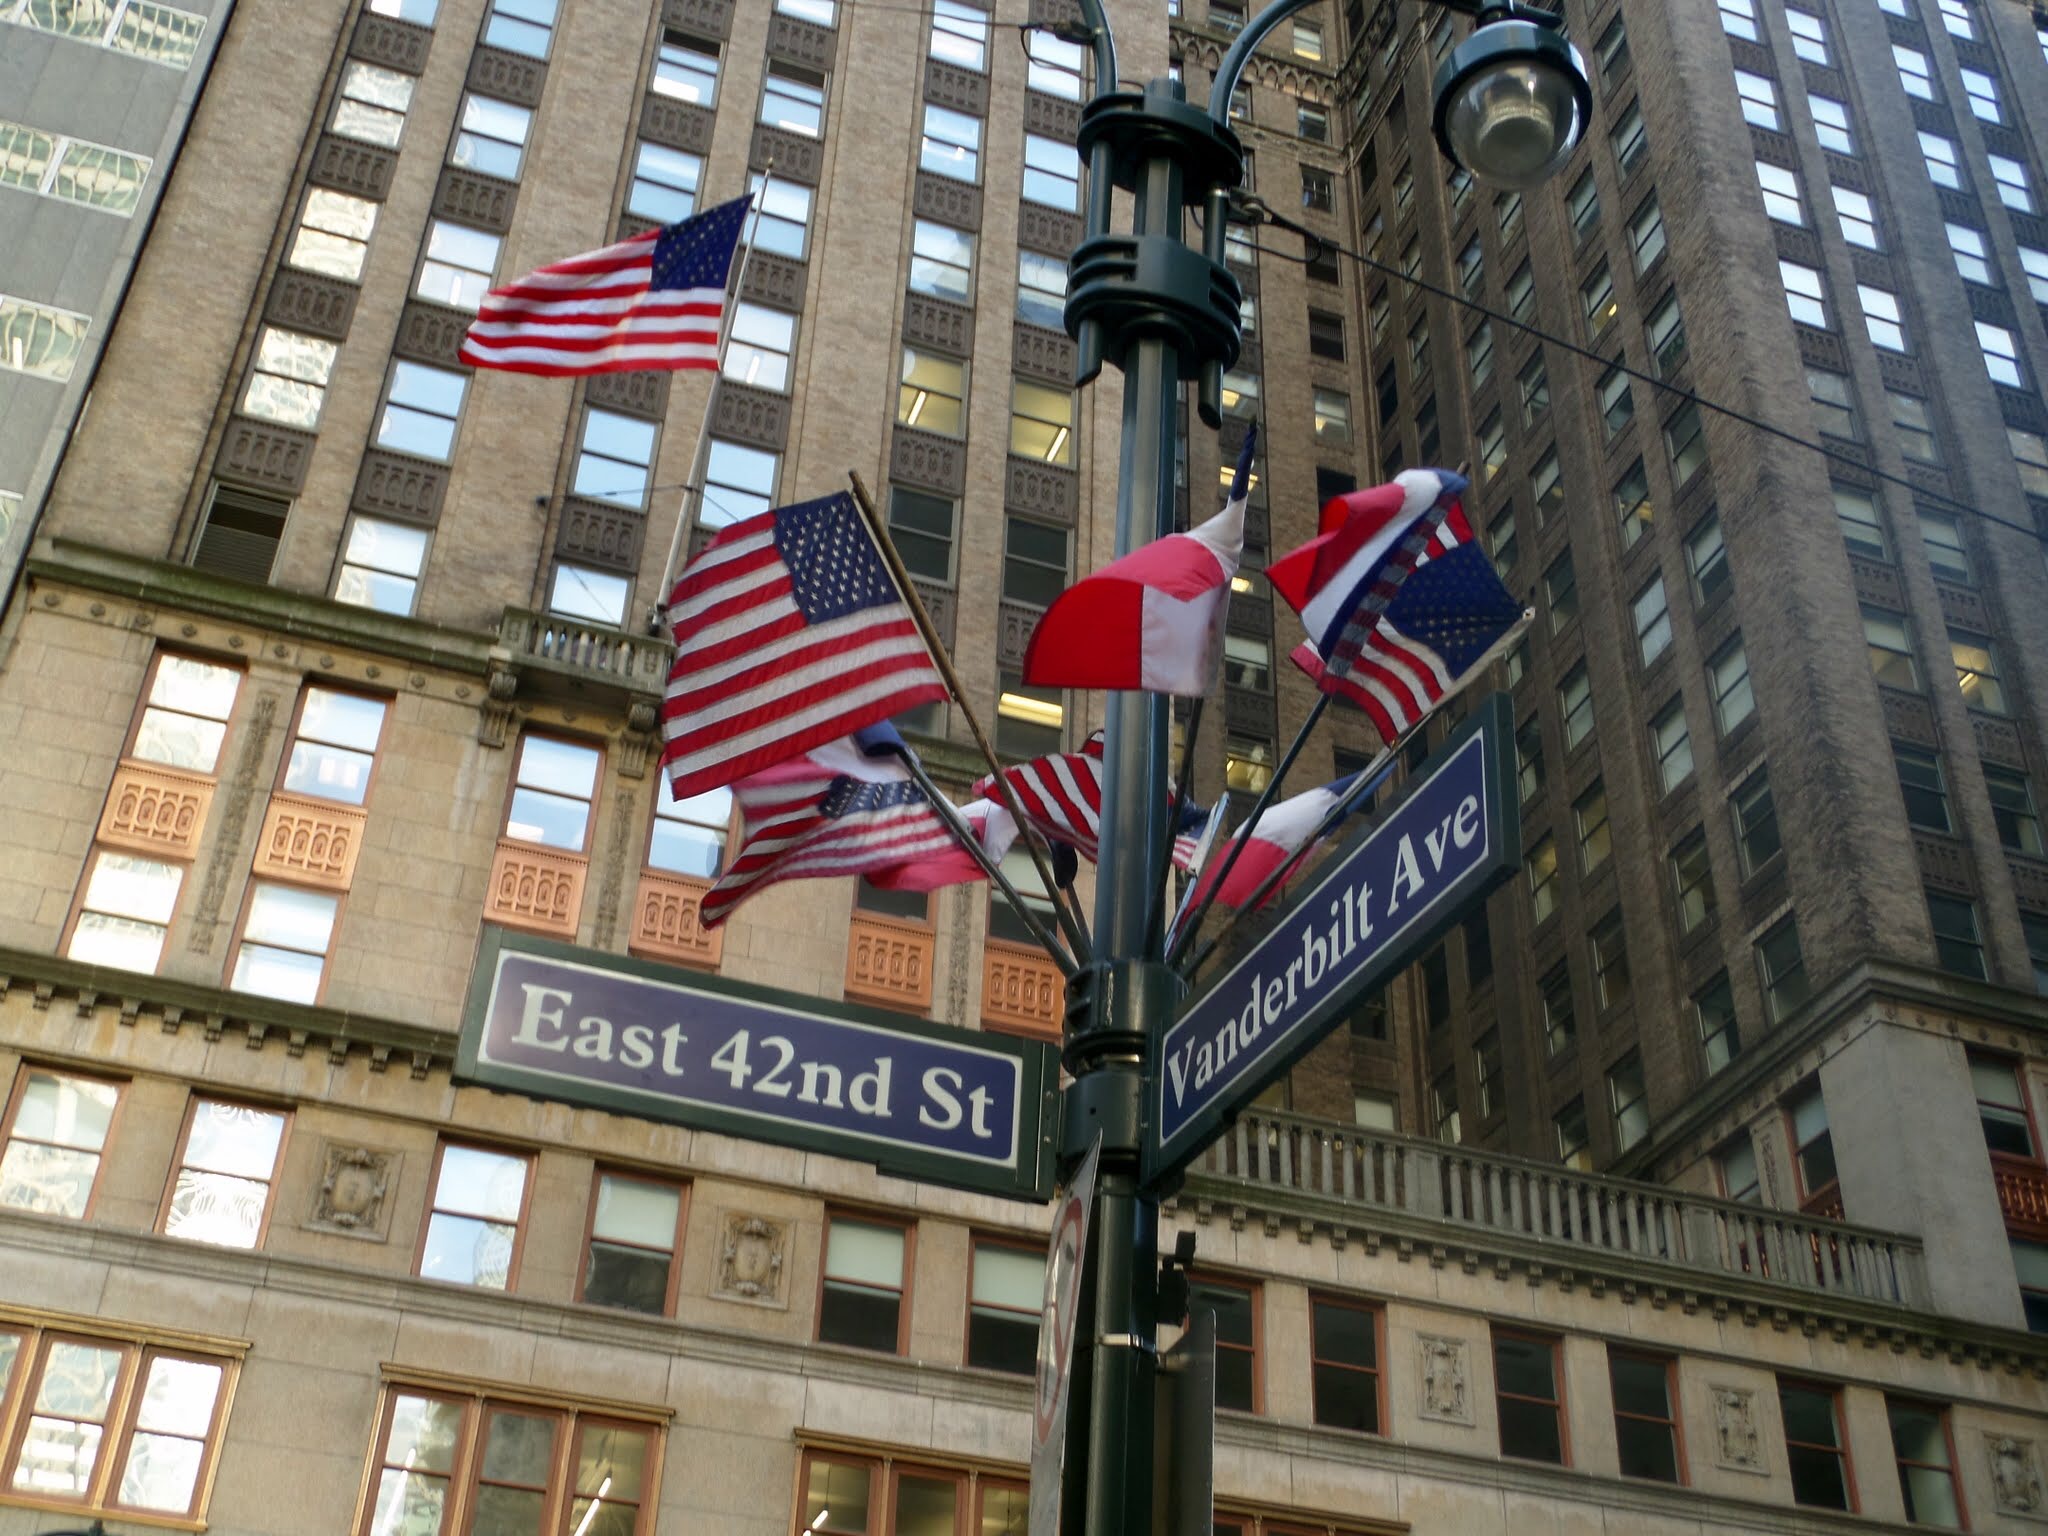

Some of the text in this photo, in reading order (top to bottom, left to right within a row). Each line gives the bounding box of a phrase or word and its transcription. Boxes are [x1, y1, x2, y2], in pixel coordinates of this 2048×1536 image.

[510, 982, 995, 1138] East 42nd St
[1167, 794, 1481, 1110] Vanderbilt Ave
